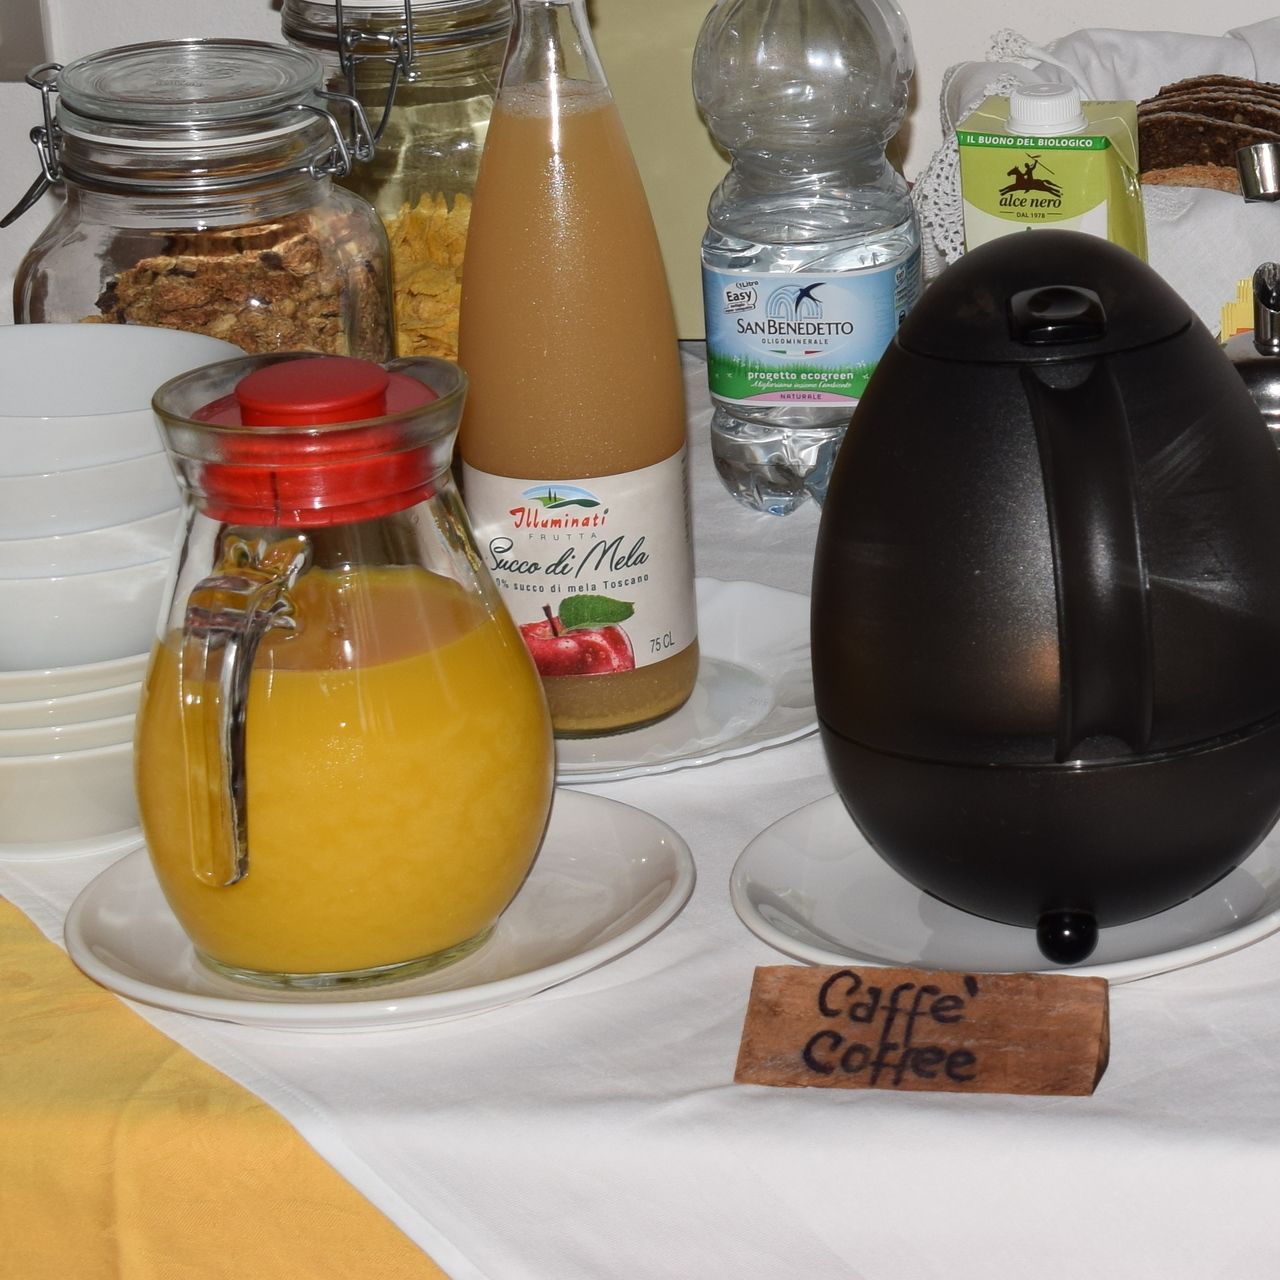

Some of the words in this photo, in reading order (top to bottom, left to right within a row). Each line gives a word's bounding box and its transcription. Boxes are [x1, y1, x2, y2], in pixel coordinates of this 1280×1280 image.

[978, 137, 1014, 146] BUONO
[1016, 138, 1035, 146] DEL
[1038, 138, 1093, 147] BIOLOGICO
[999, 193, 1027, 208] alce
[1030, 197, 1062, 209] nero
[726, 291, 752, 302] Easy
[737, 318, 766, 335] SAN
[768, 320, 854, 335] BENEDETTO
[748, 371, 797, 382] progetto
[800, 371, 854, 382] ecogreen
[509, 507, 609, 530] Illuminati
[528, 532, 599, 541] FRUTTA
[488, 537, 541, 572] Succo
[545, 546, 576, 576] di
[575, 535, 650, 579] Mela
[513, 582, 545, 594] succo
[550, 582, 562, 593] di
[567, 582, 597, 593] mela
[602, 573, 650, 591] Toscano
[650, 638, 662, 654] 75
[662, 631, 676, 651] CL
[803, 1030, 977, 1086] Coffee
